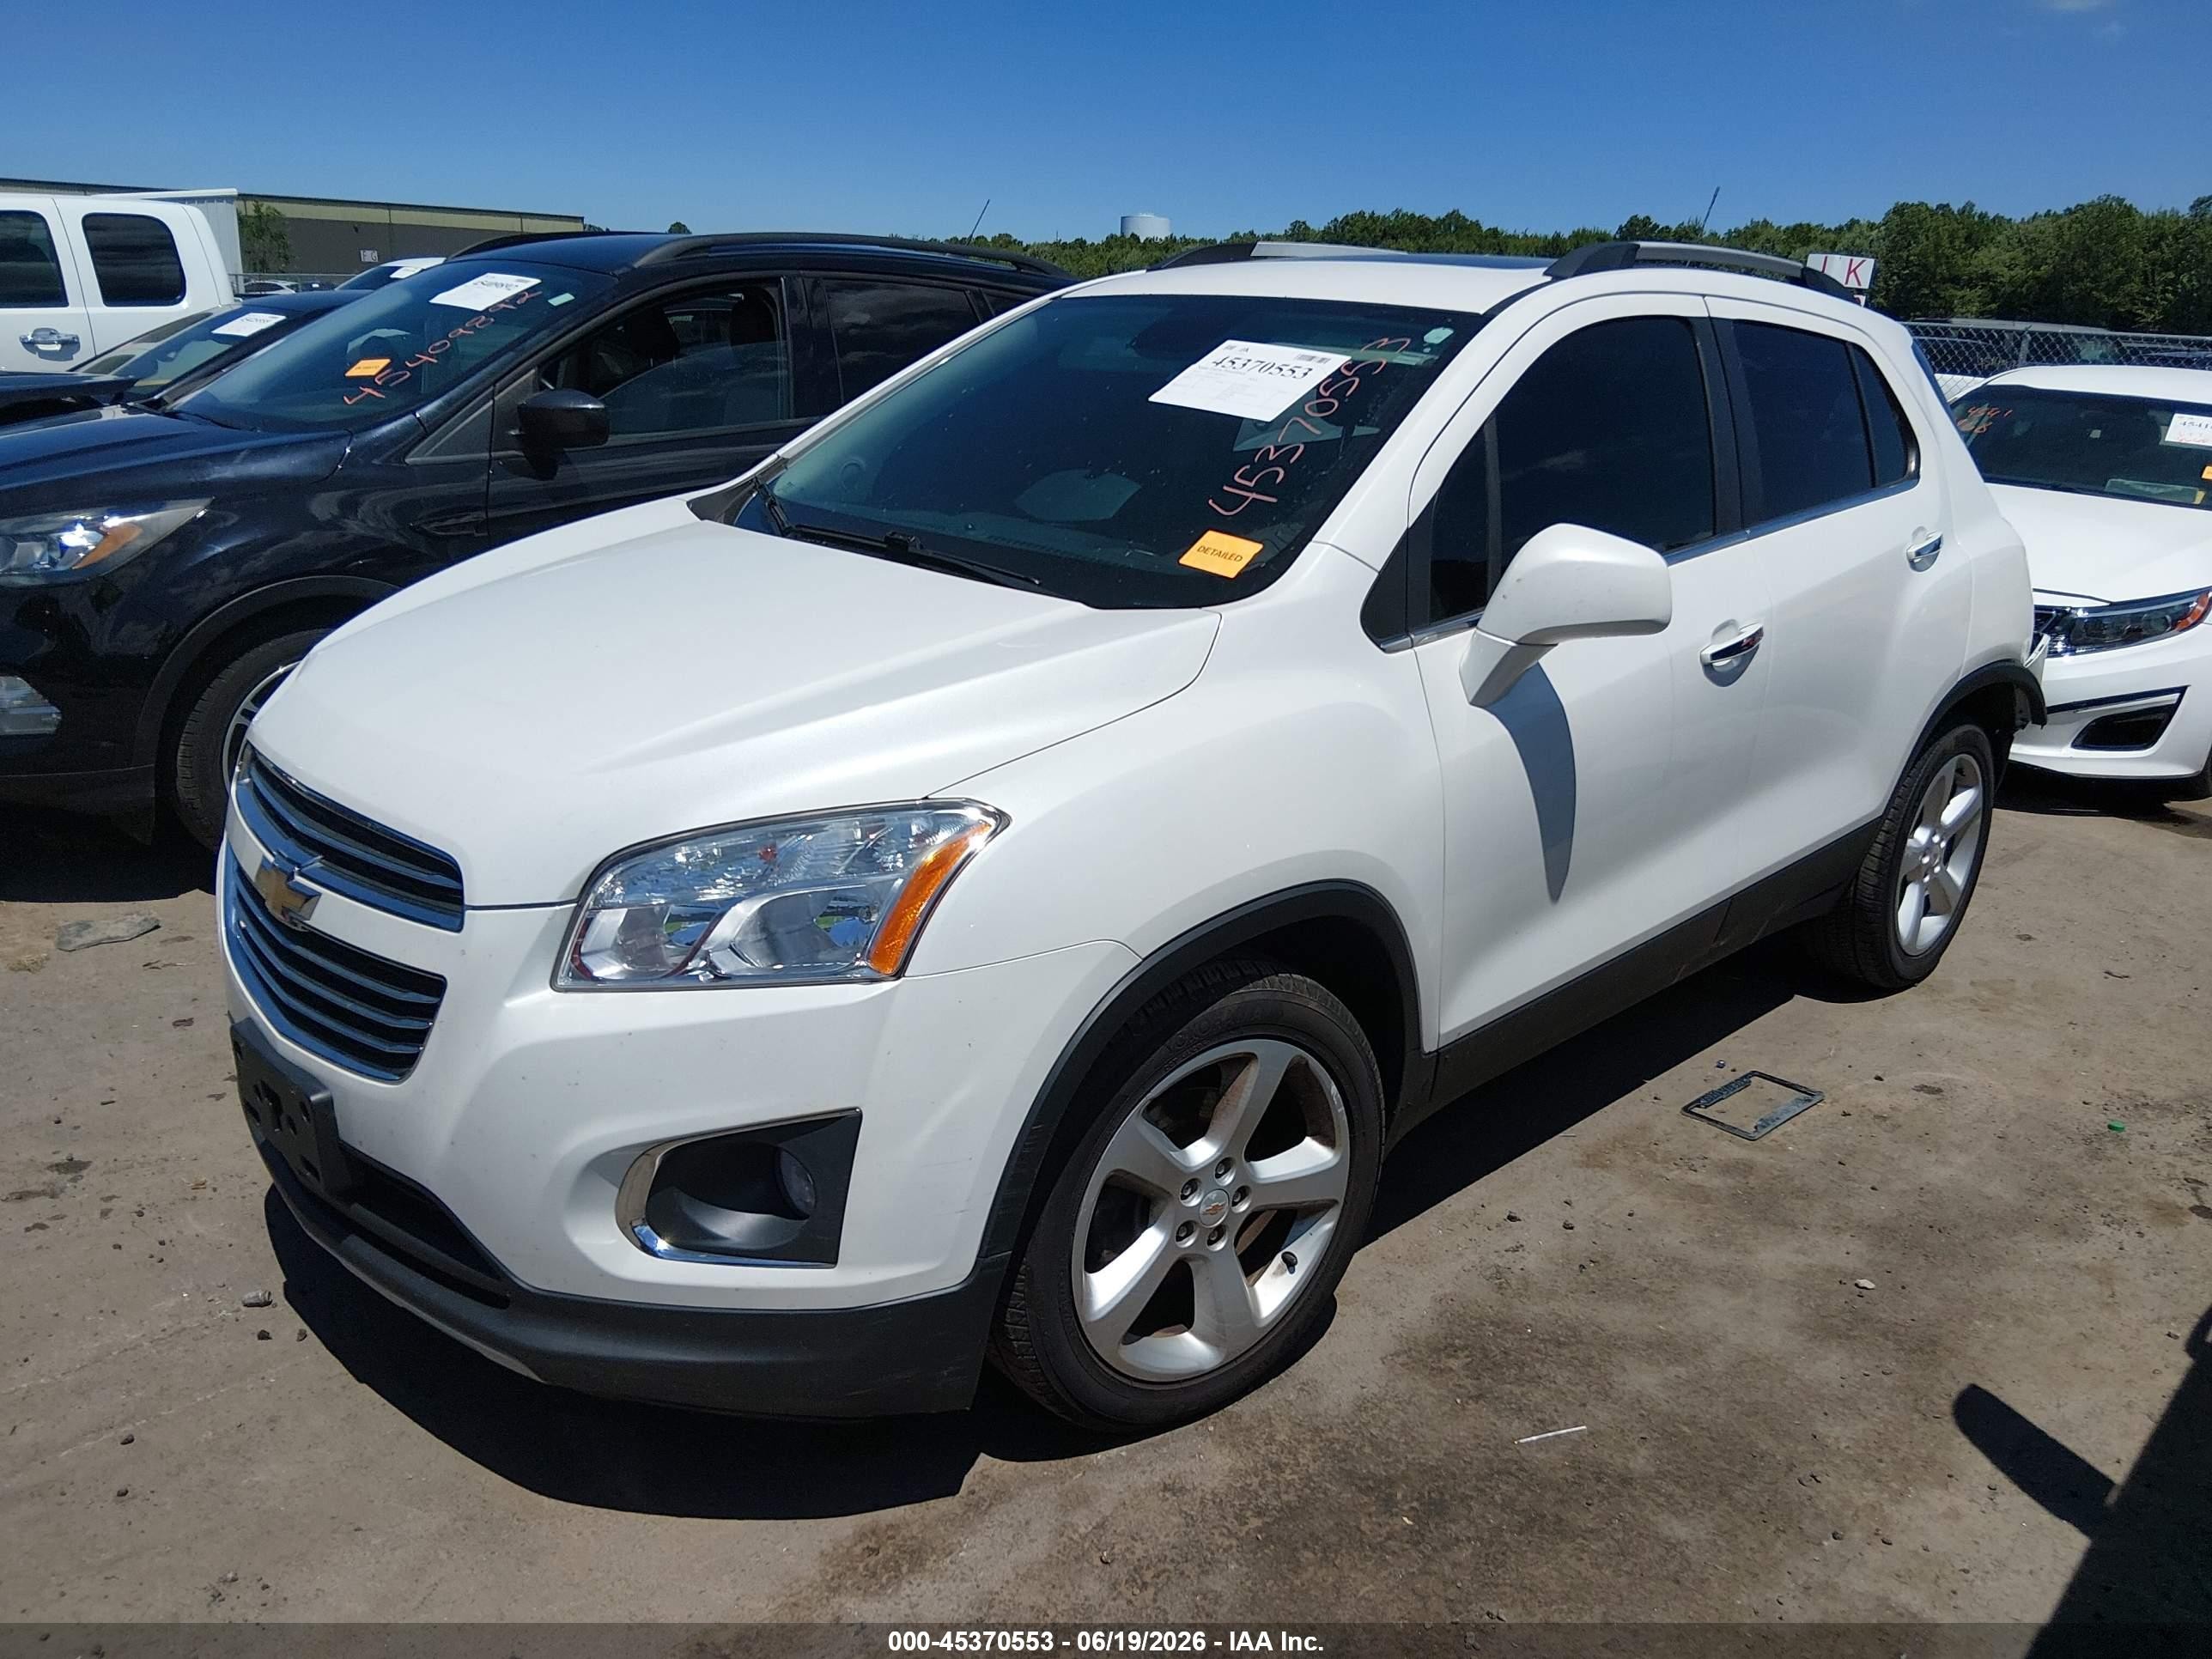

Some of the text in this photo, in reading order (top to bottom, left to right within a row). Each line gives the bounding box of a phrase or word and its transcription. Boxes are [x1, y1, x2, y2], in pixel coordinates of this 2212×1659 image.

[1844, 258, 1867, 287] K
[1212, 356, 1313, 380] 45370553
[1207, 337, 1412, 516] 45370553
[1197, 545, 1243, 562] DETAILED
